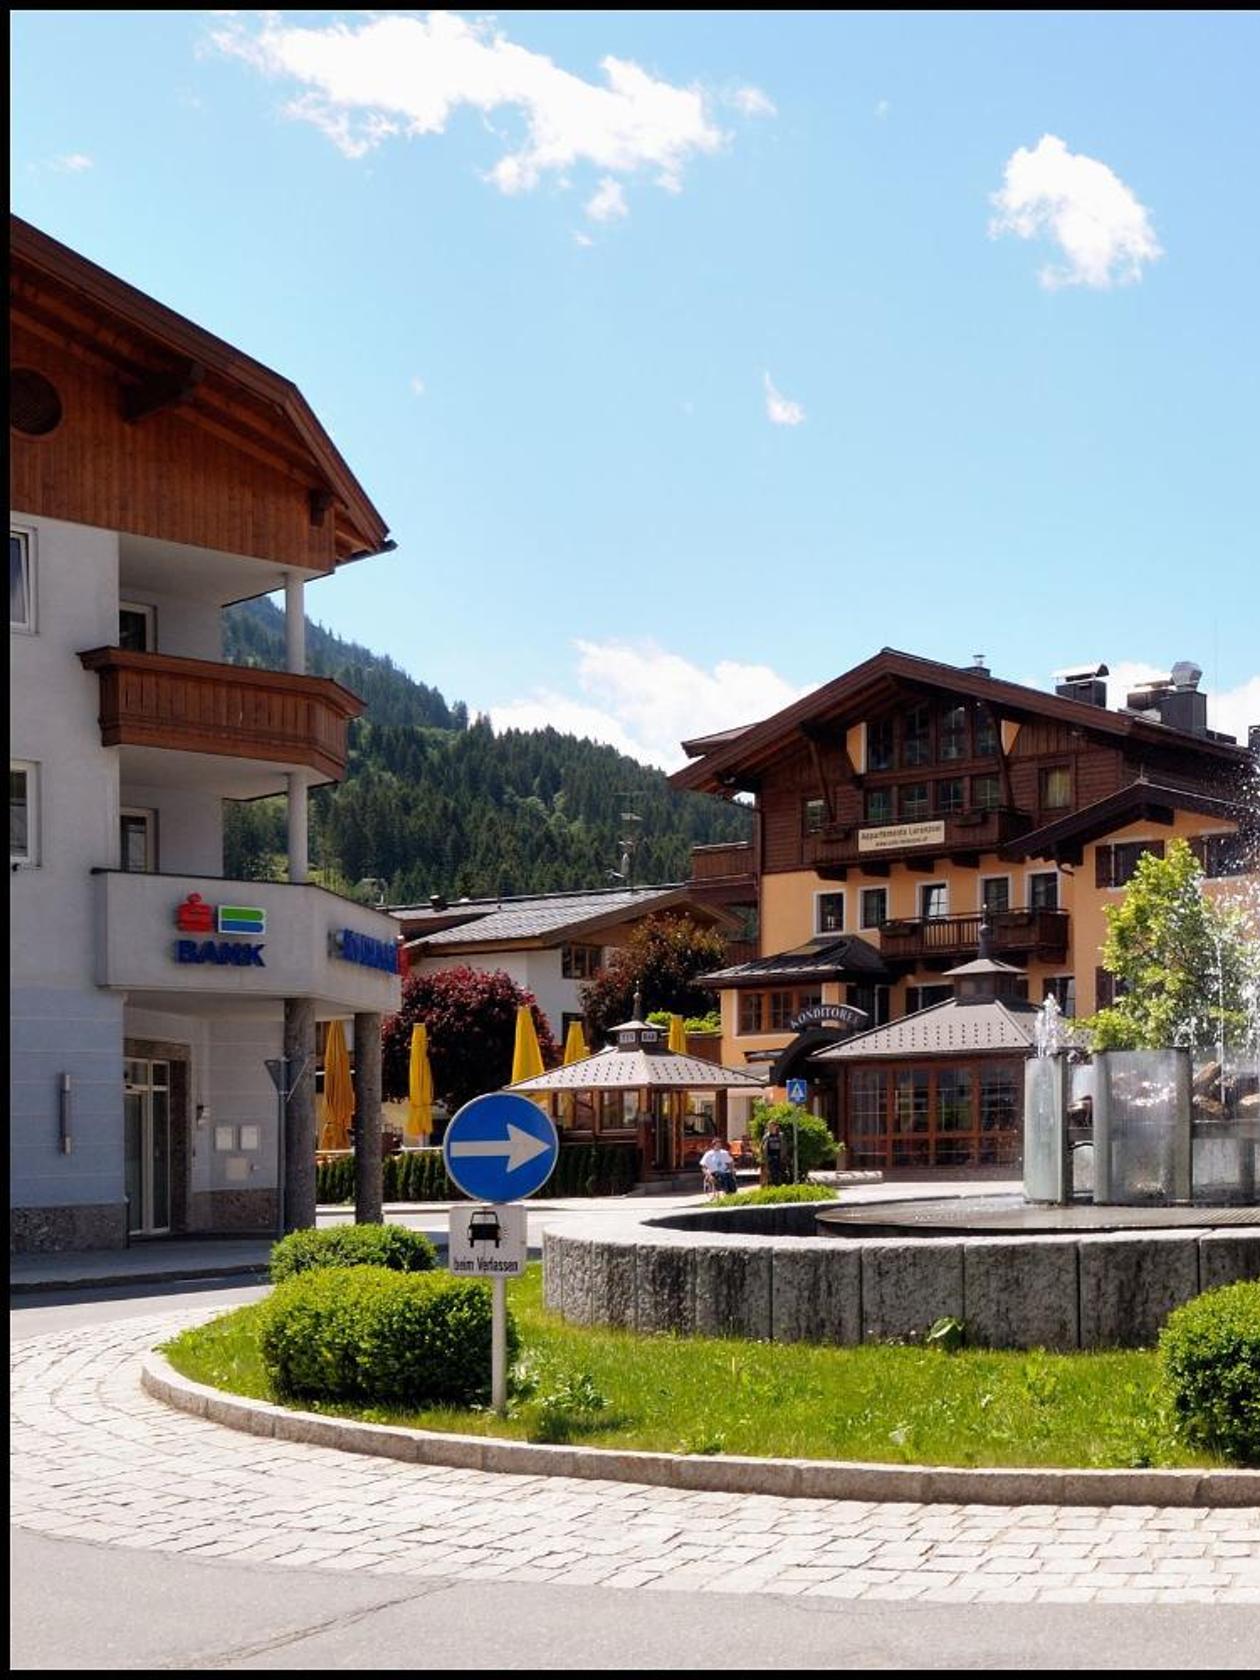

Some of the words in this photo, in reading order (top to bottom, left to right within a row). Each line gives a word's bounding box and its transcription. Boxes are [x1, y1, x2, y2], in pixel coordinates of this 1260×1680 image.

[175, 939, 266, 967] BANK
[453, 1257, 474, 1271] beim
[477, 1256, 518, 1272] Verlassen
